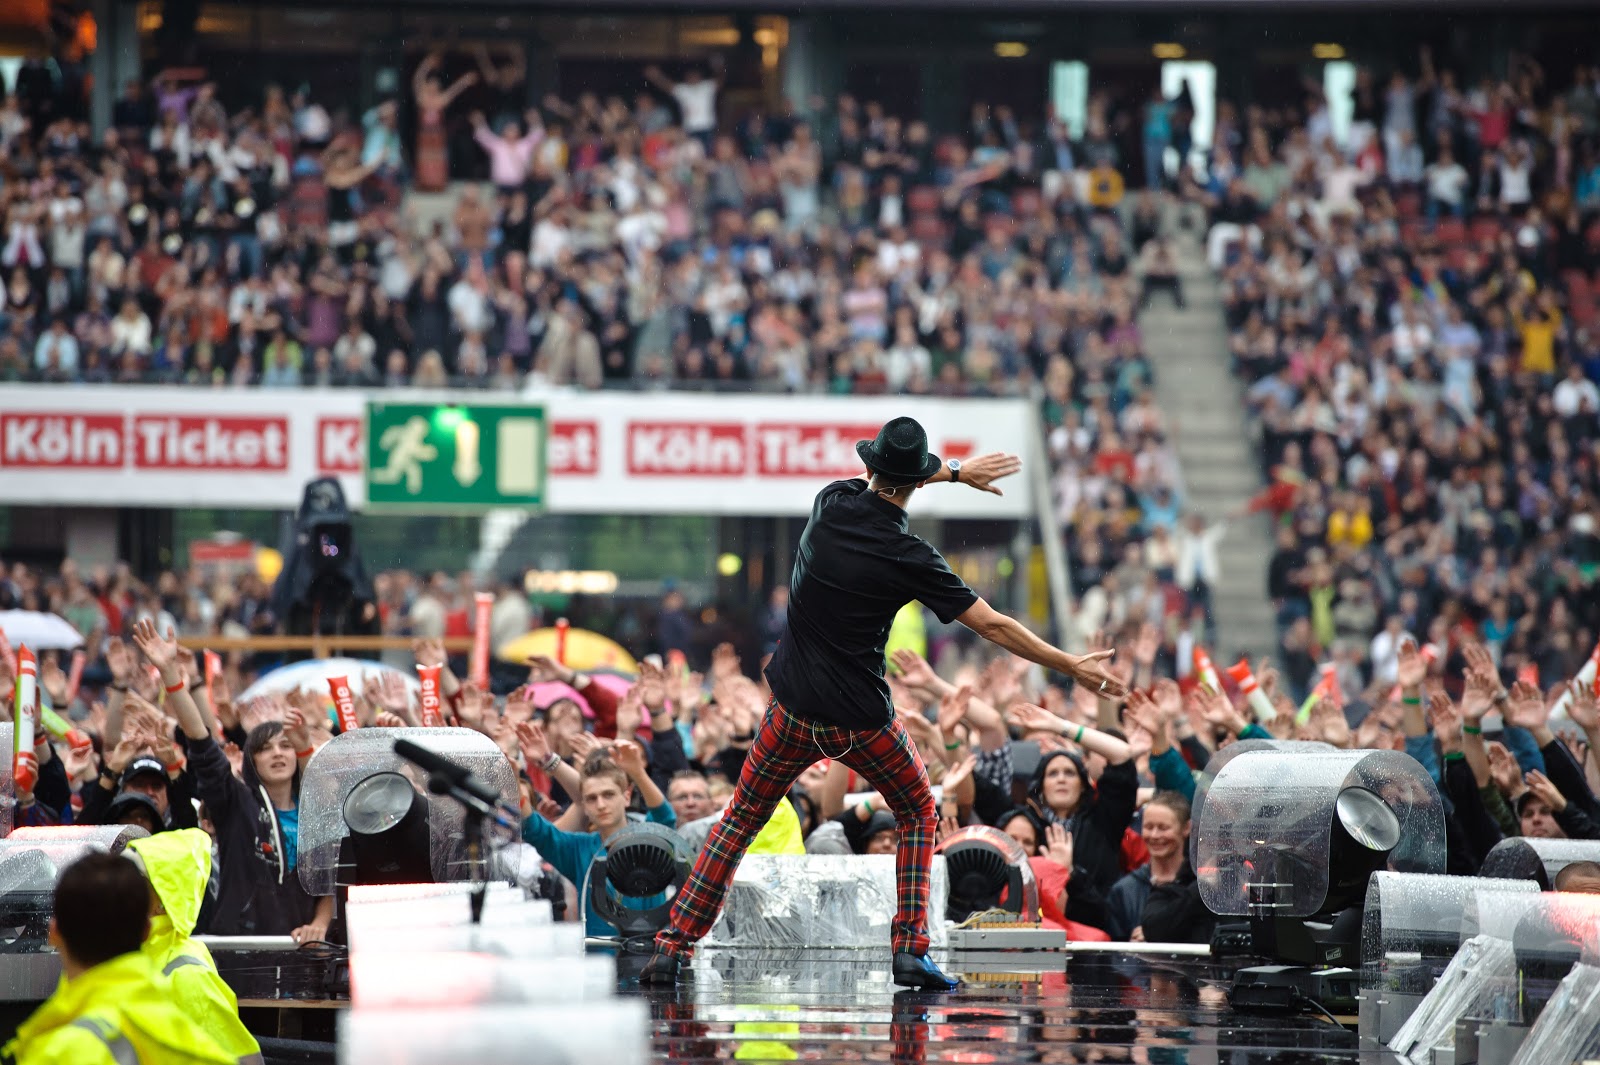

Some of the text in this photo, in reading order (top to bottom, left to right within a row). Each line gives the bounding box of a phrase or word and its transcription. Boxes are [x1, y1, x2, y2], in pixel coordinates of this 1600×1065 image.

[4, 417, 283, 465] Köln Ticket
[324, 422, 366, 466] K
[632, 427, 742, 471] Köln
